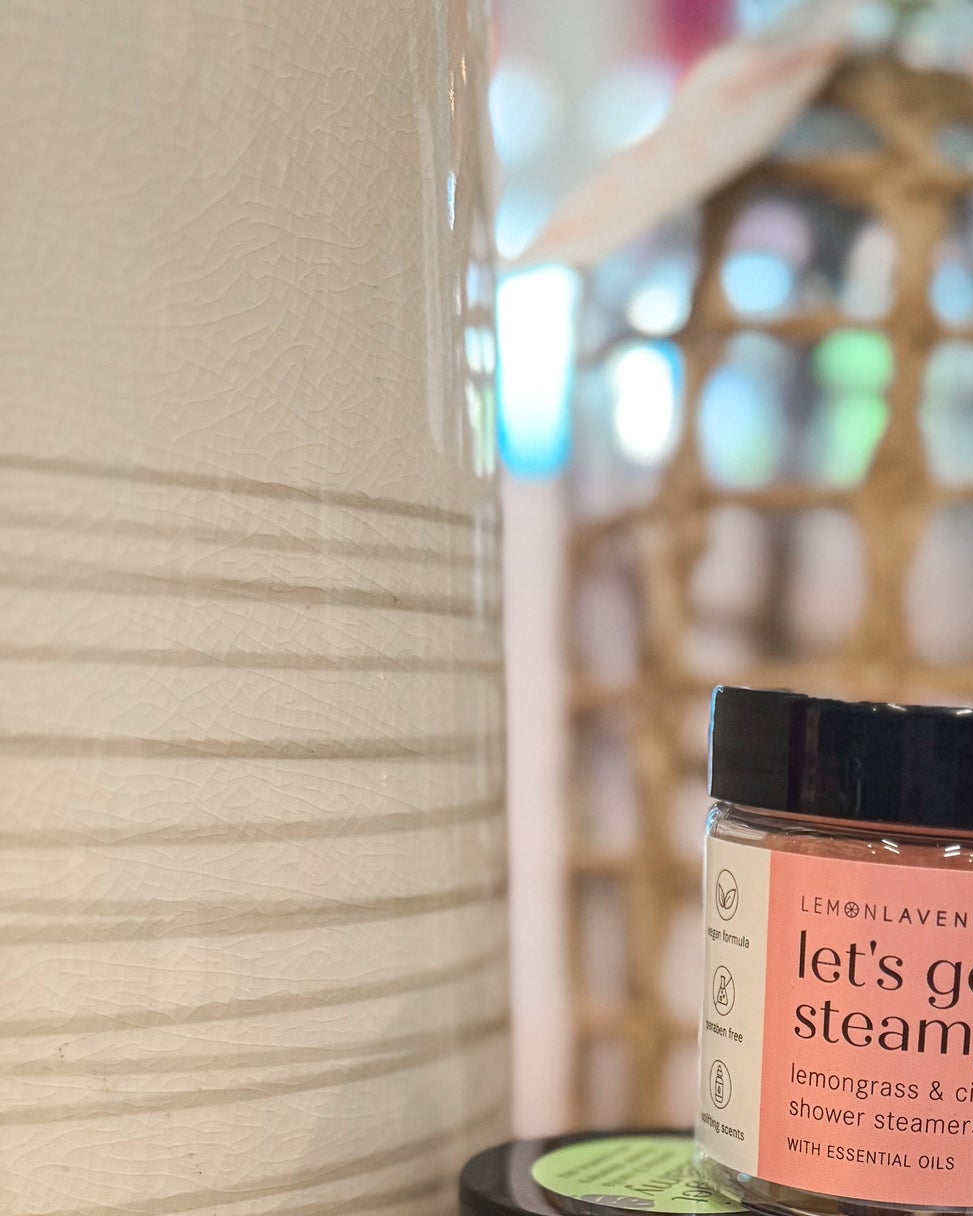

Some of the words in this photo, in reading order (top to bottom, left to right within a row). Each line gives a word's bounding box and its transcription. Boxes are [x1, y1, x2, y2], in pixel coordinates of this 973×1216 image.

[723, 929, 749, 948] formula
[798, 929, 904, 992] let's
[729, 1027, 743, 1043] free
[790, 1062, 919, 1101] lemongrass
[928, 1082, 943, 1101] &
[788, 1099, 865, 1128] shower
[721, 1123, 744, 1141] scents
[787, 1137, 821, 1158] WITH
[827, 1144, 910, 1168] ESSENTIAL
[918, 1155, 955, 1171] OILS
